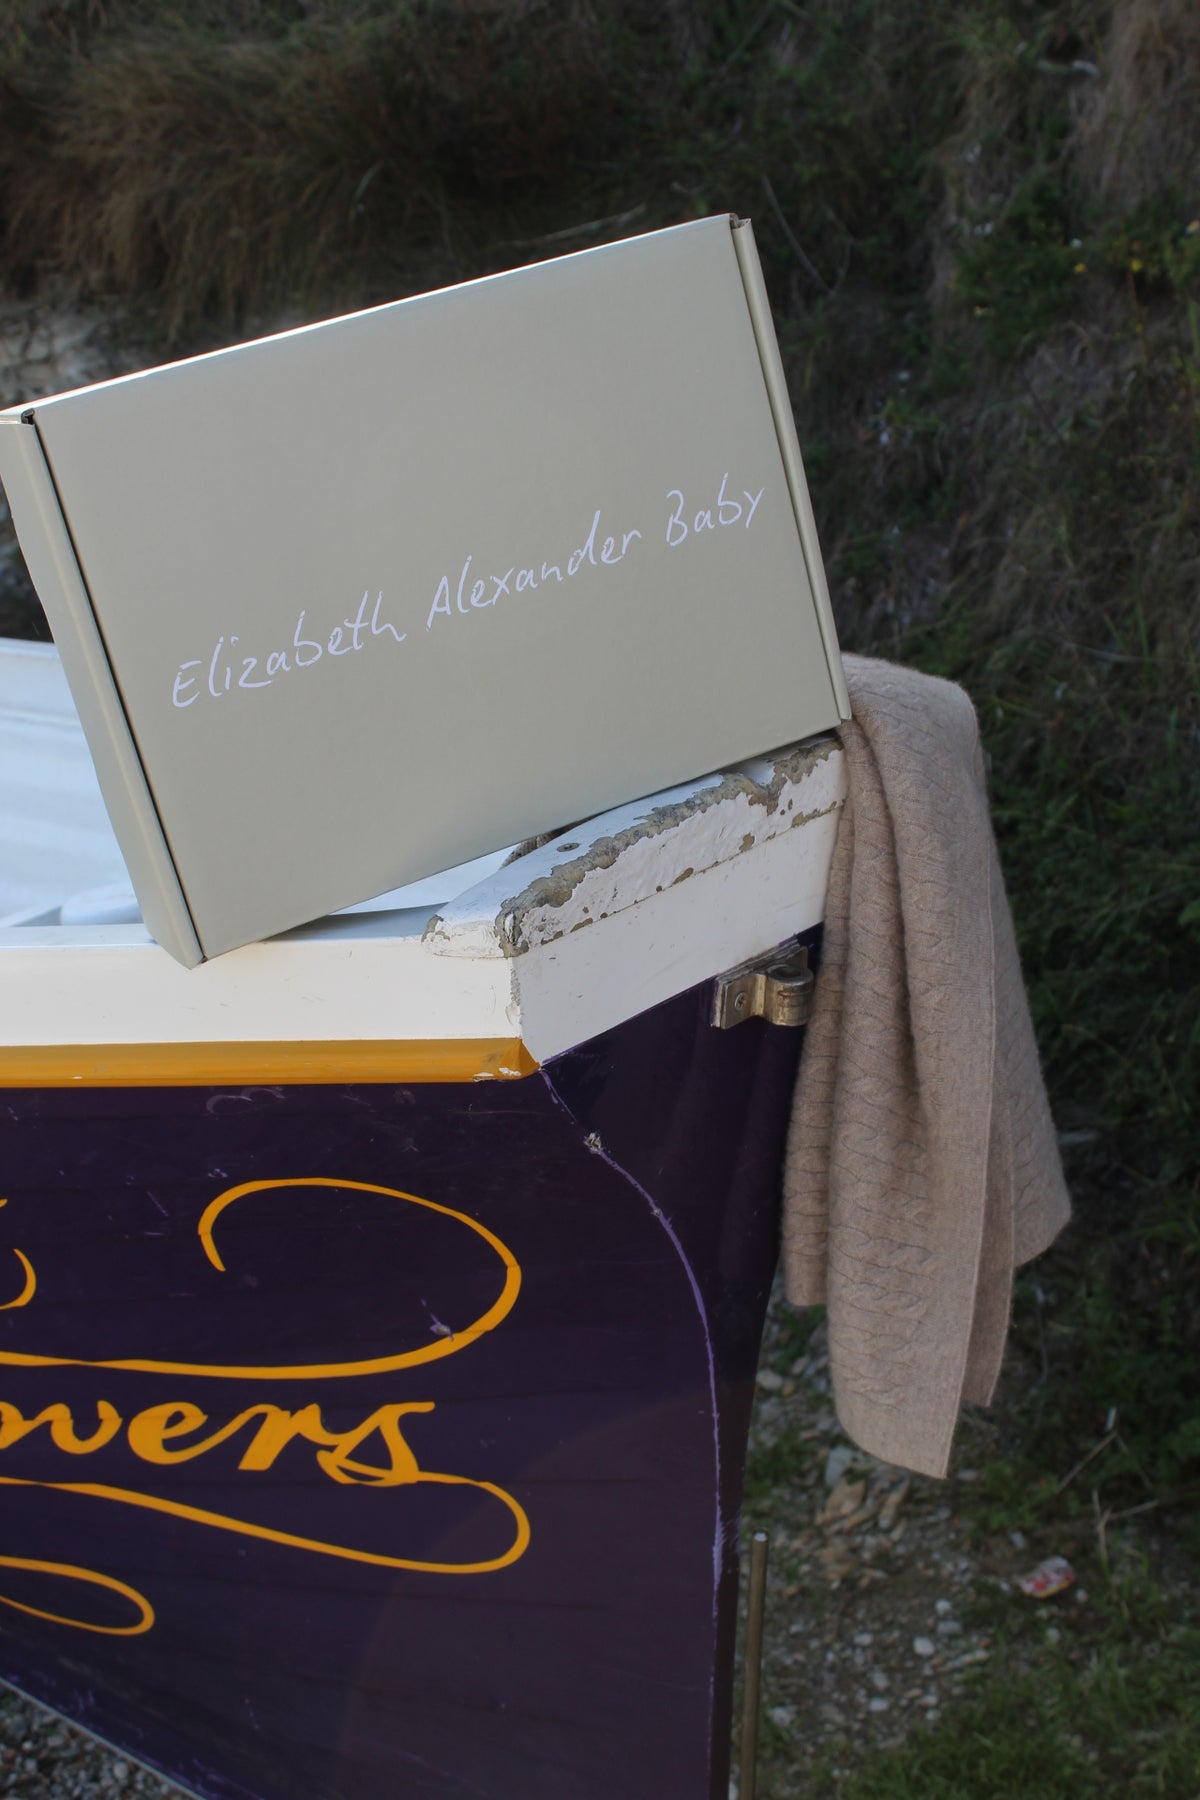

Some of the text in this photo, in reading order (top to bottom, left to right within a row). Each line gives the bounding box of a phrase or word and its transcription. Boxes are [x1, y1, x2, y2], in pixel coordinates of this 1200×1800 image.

[172, 471, 765, 708] Elizabeth Alexander Baby
